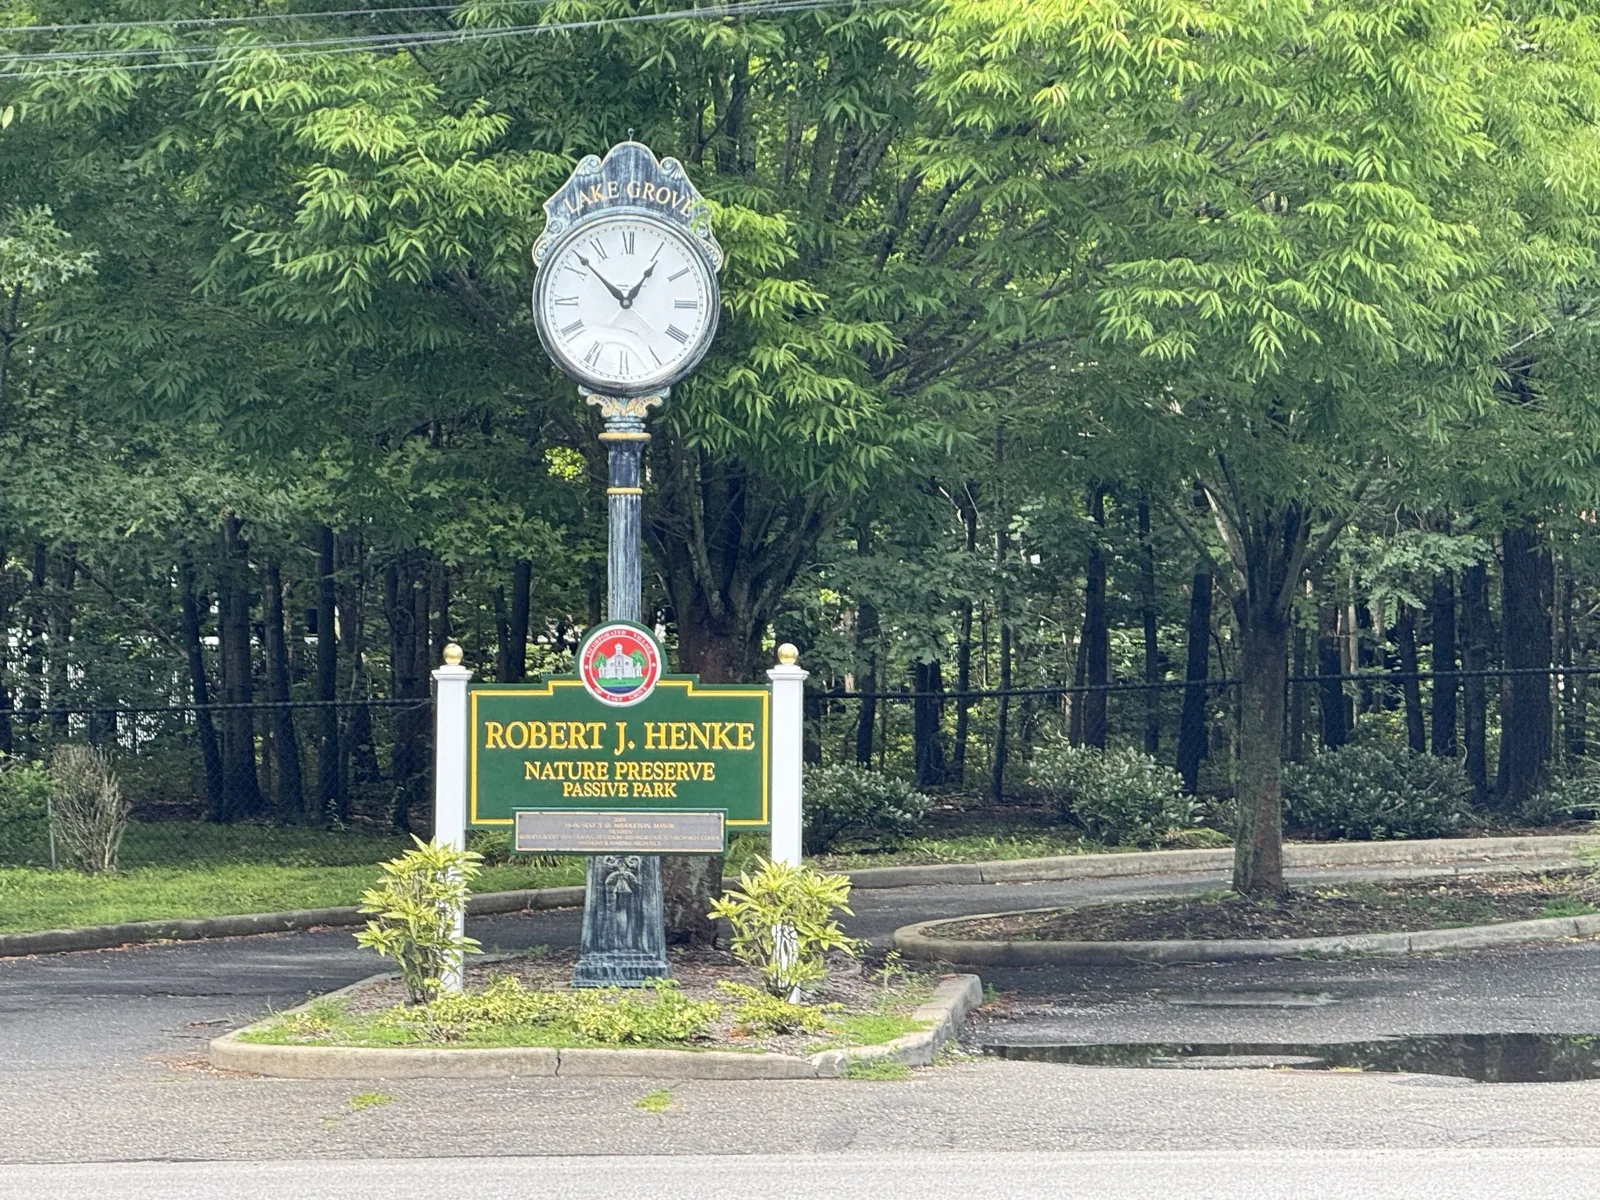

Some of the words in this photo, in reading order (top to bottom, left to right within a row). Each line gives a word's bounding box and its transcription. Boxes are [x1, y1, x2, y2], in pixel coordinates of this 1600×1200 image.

[564, 181, 619, 214] LAKE
[626, 181, 695, 218] GROVE
[485, 721, 606, 749] ROBERT
[614, 722, 635, 755] J.
[644, 722, 755, 750] HENKE
[524, 761, 609, 780] NATURE
[614, 761, 715, 781] PRESERVE
[563, 782, 628, 797] PASSIVE
[633, 783, 677, 797] PARK
